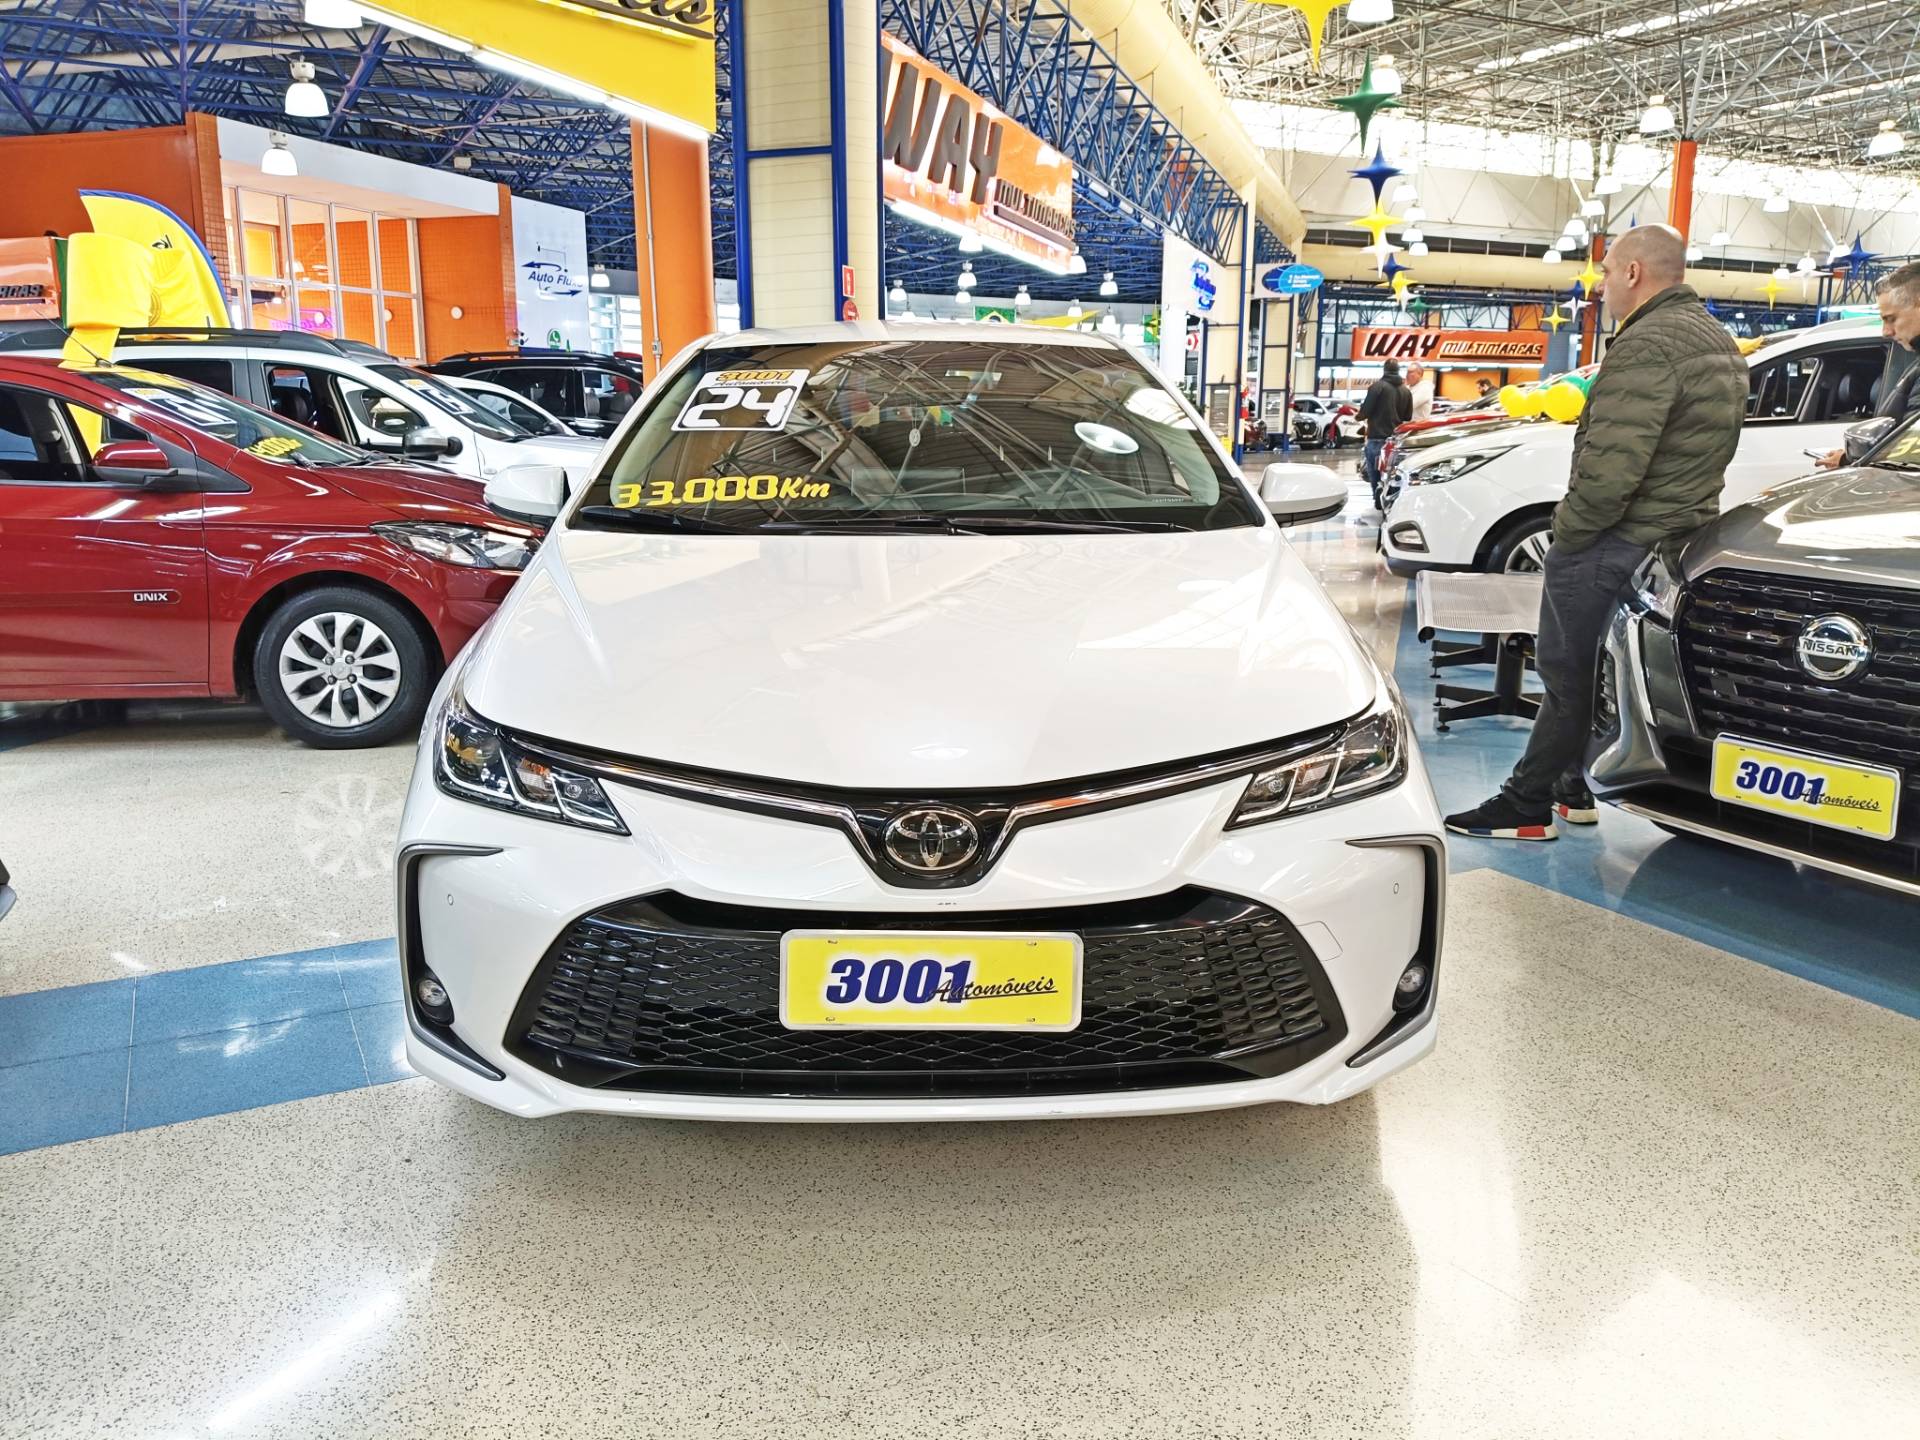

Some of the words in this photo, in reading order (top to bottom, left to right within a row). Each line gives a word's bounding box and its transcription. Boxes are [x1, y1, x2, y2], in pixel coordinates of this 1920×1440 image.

[528, 271, 554, 284] Auto
[1364, 333, 1440, 358] WAY
[1442, 340, 1544, 355] MULTIMARCAS
[716, 370, 794, 382] 3001
[682, 387, 794, 427] 24
[133, 592, 168, 602] ONIX
[1802, 640, 1858, 656] NISSAN
[1736, 761, 1825, 805] 3001
[826, 958, 972, 1004] 3001
[927, 975, 1056, 1003] Automóveis
